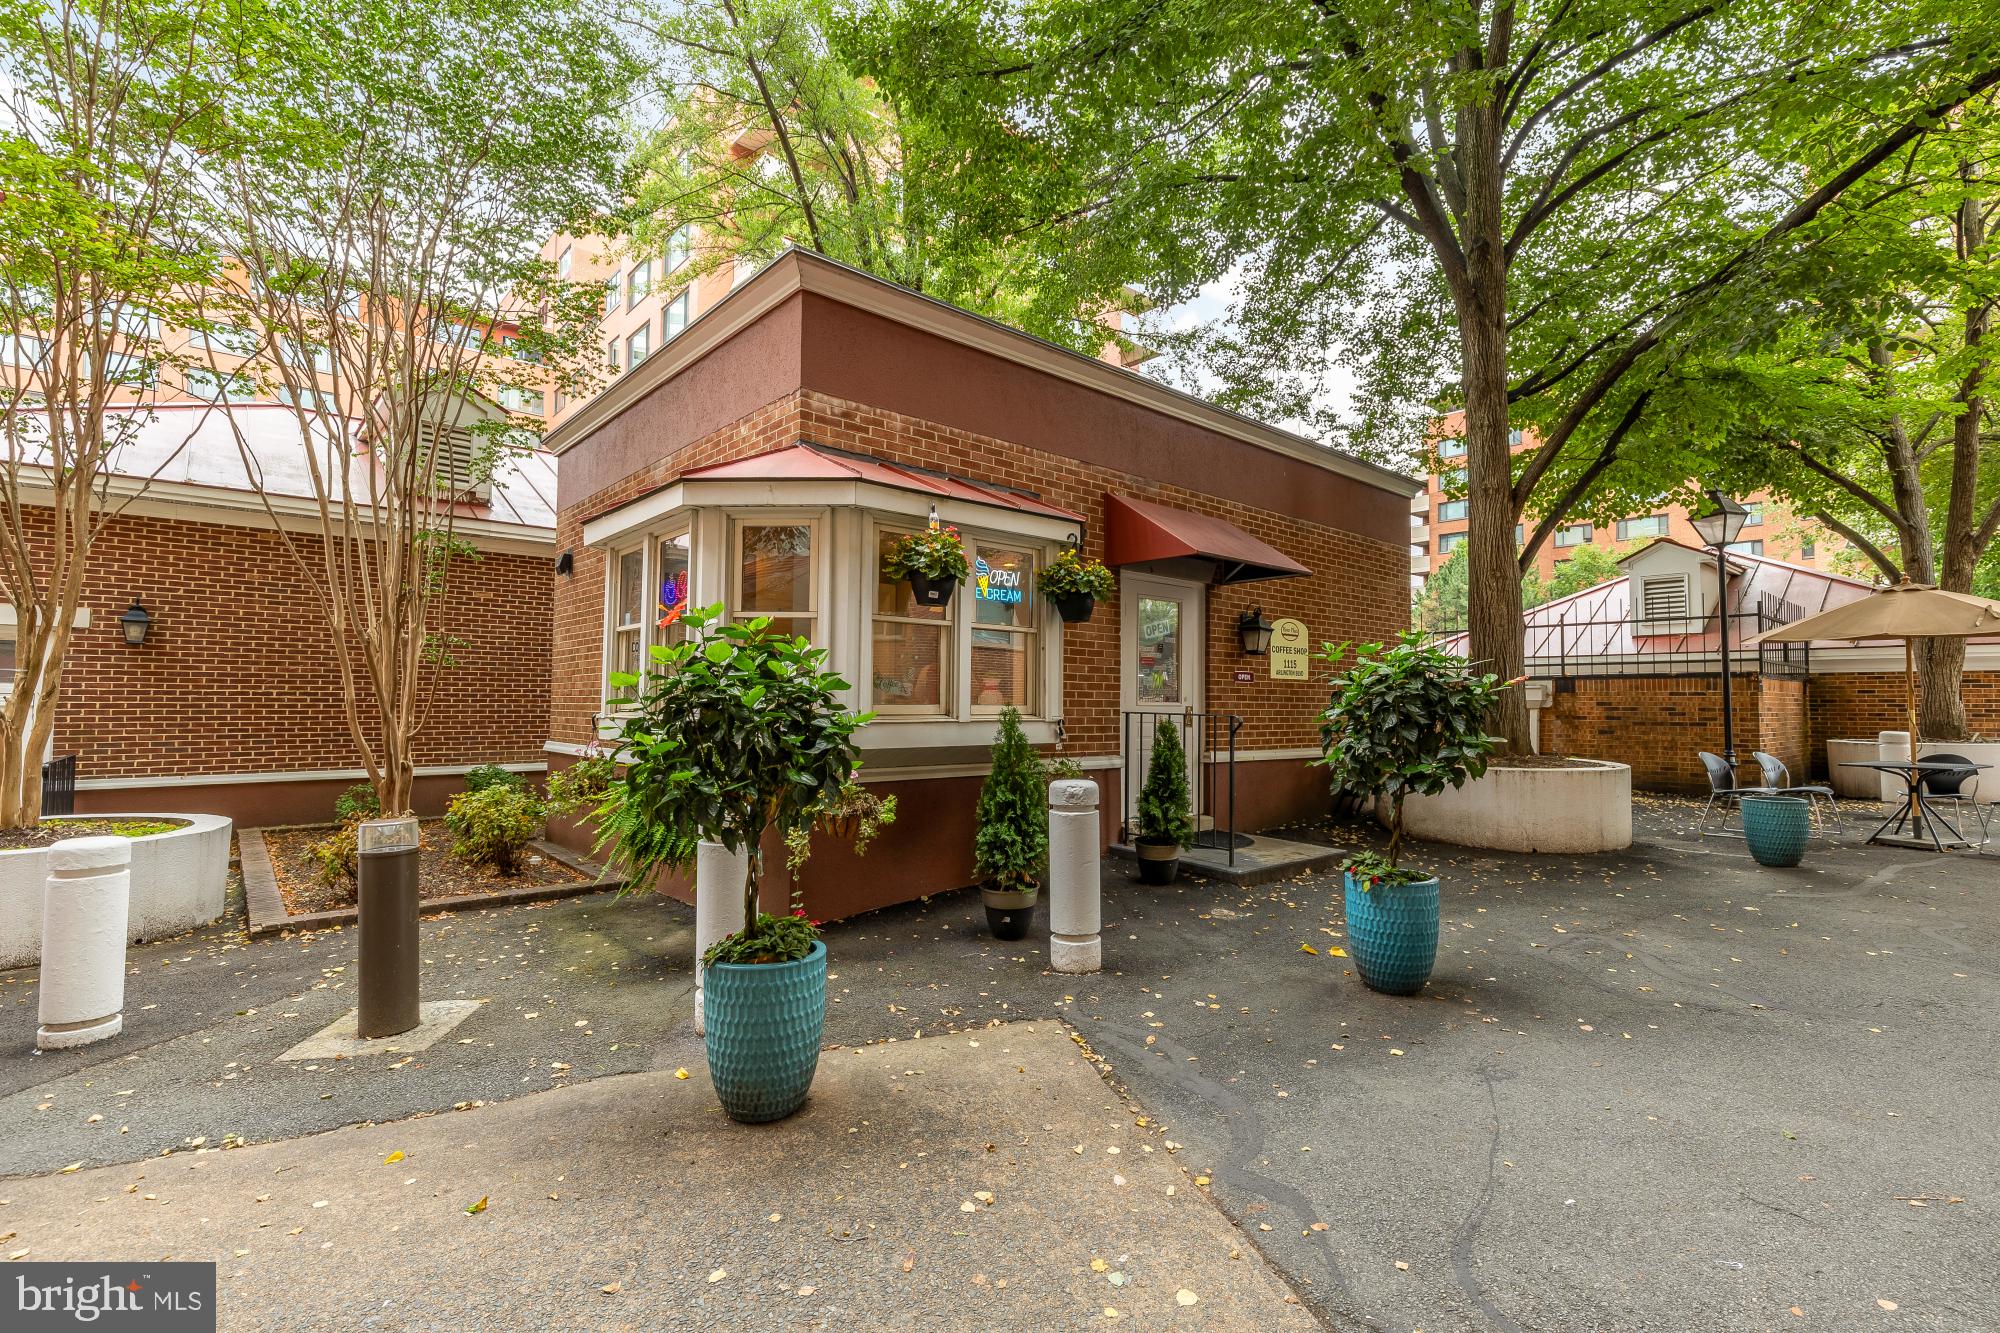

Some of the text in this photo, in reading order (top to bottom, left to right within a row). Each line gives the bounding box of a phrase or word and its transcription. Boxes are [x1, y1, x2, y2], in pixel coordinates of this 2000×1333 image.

[990, 569, 1020, 586] OPEN
[986, 588, 1021, 602] CREAM
[1145, 621, 1169, 637] OPEN
[1272, 645, 1308, 656] COFFEE SHOP
[1283, 659, 1297, 669] 1115
